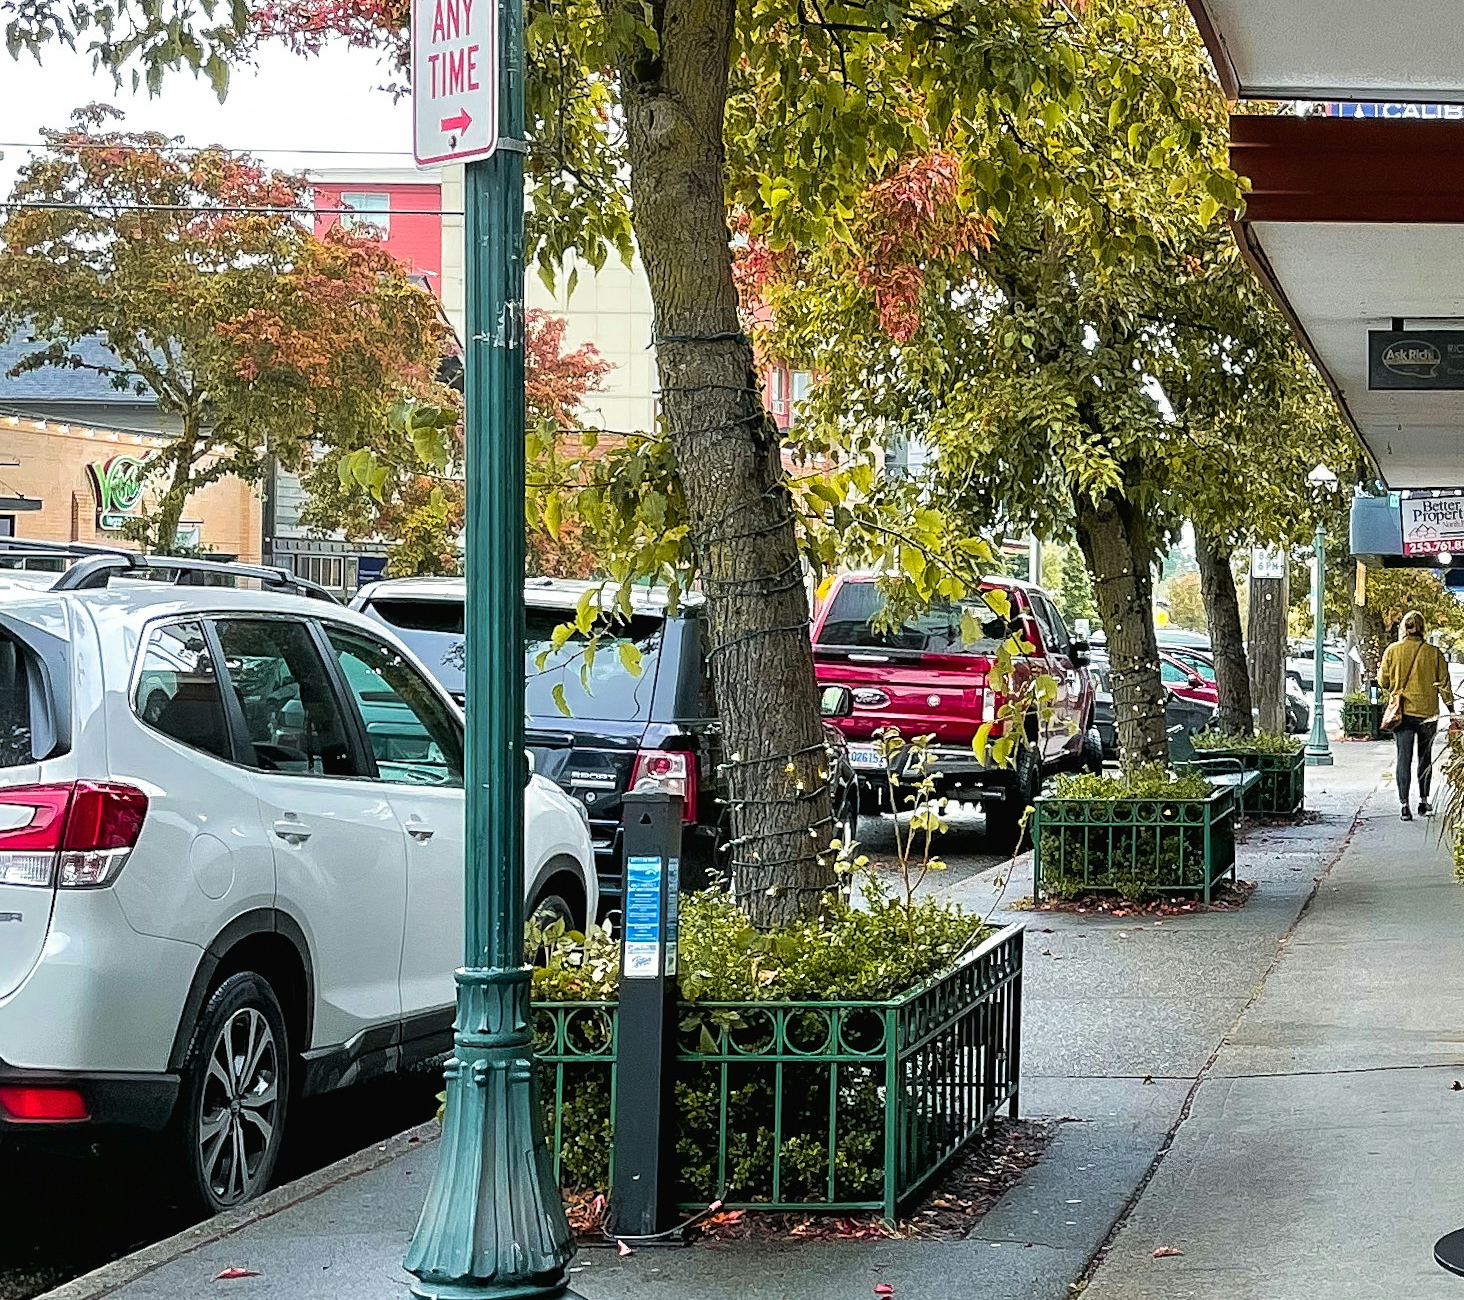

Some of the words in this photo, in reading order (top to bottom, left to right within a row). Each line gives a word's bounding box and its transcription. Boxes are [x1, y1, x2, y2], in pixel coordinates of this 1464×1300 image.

[428, 44, 480, 100] TIME
[1386, 348, 1408, 361] Ask
[1422, 500, 1461, 512] Better
